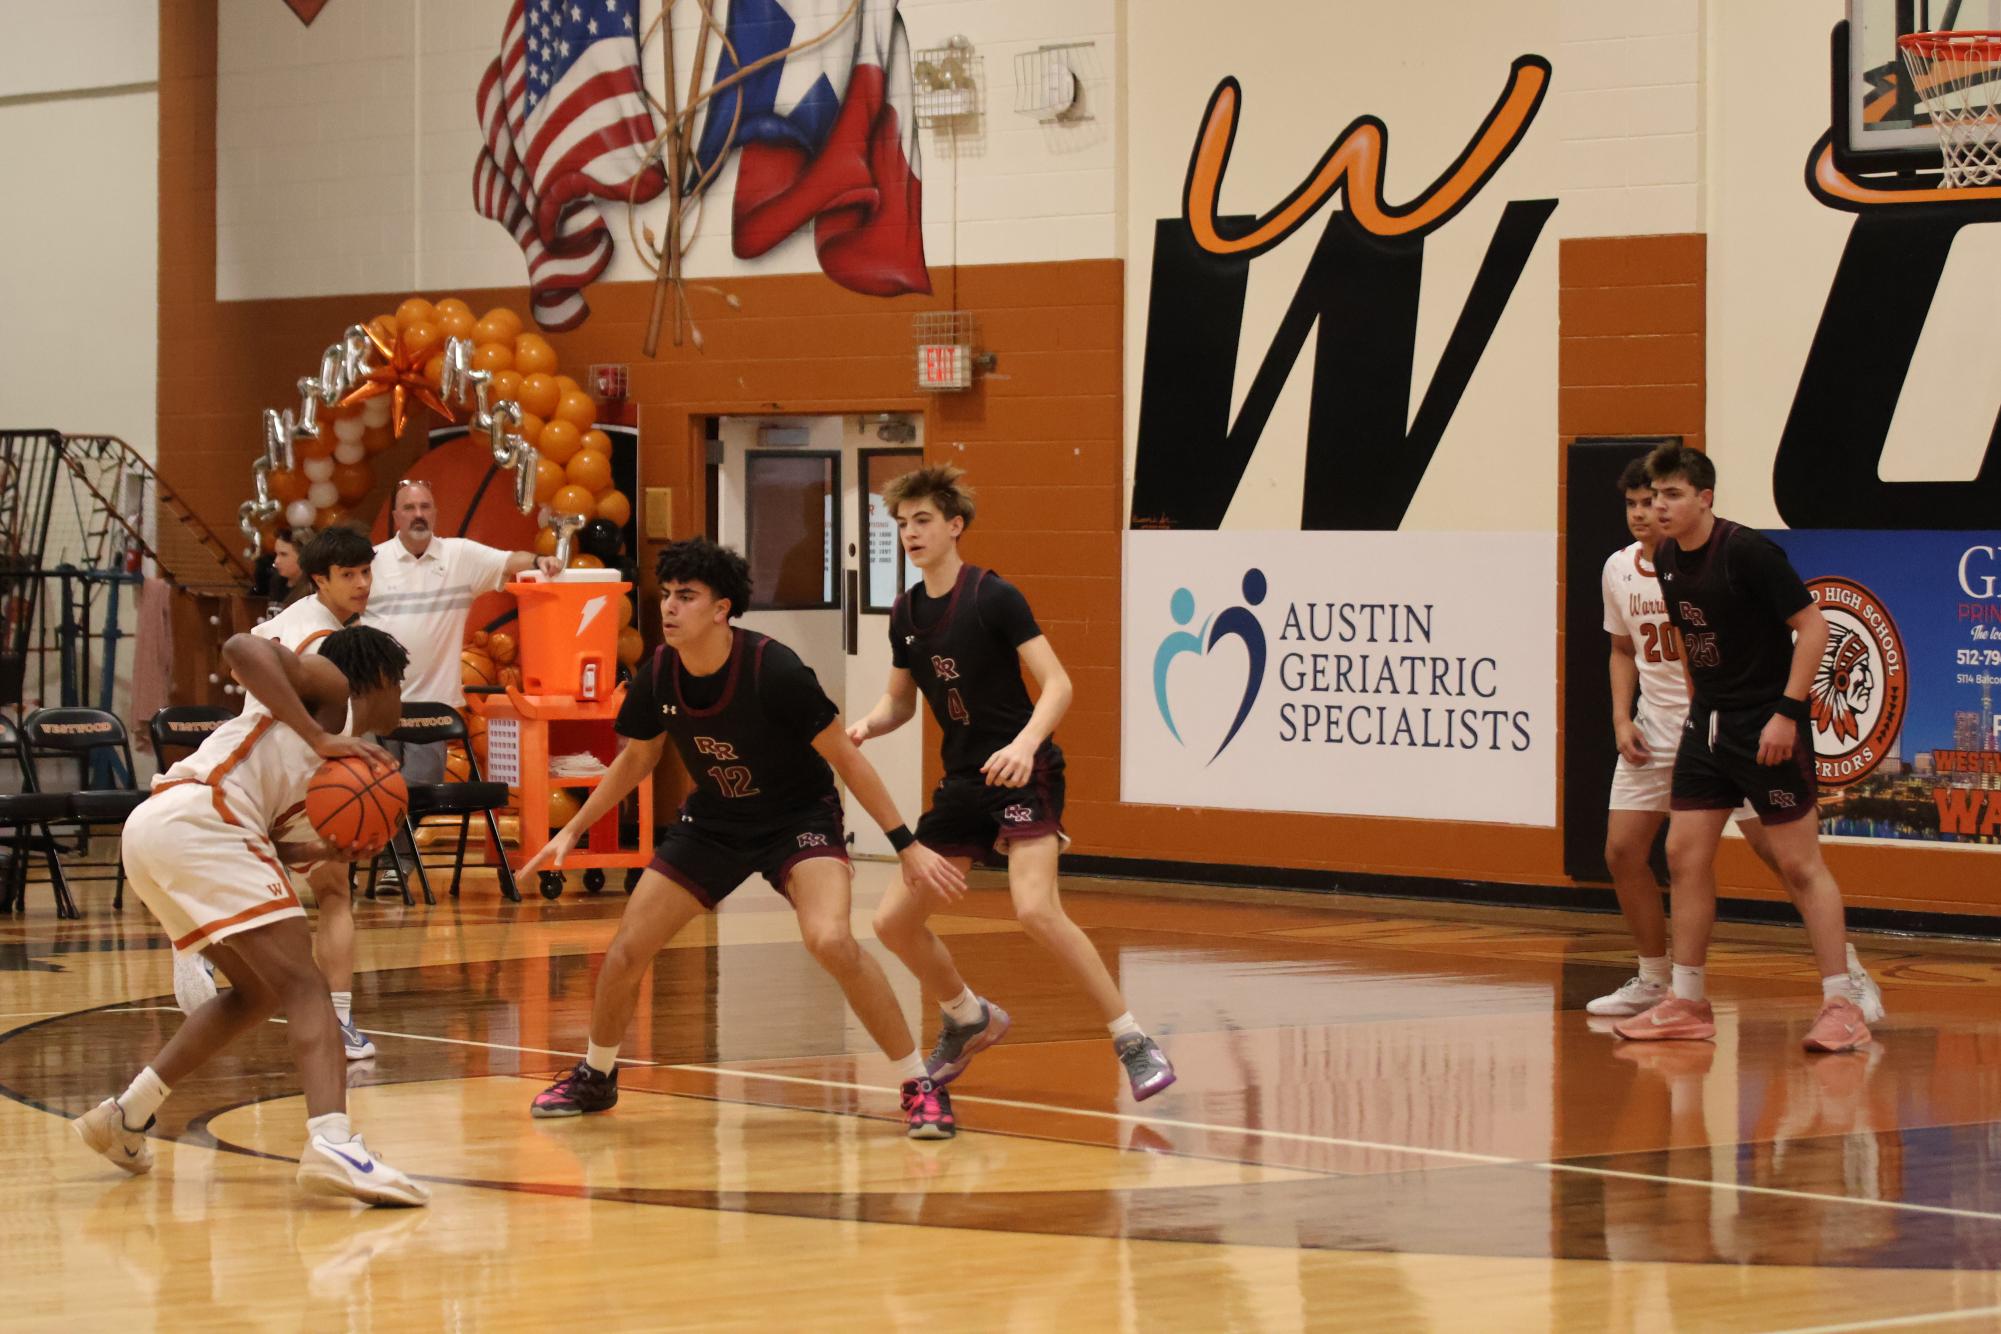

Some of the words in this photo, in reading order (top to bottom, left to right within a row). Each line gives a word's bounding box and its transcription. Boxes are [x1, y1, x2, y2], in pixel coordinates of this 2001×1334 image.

[927, 345, 955, 384] EXIT
[1958, 546, 2001, 599] G
[1279, 602, 1434, 644] AUSTIN
[1639, 621, 1680, 663] 20
[1824, 587, 1862, 610] HIGH
[1863, 604, 1900, 676] SCHOOL
[1279, 653, 1497, 698] GERIATRIC
[1956, 649, 2001, 666] 512-79
[1975, 674, 2001, 685] Balco
[948, 688, 970, 725] 4
[1279, 703, 1531, 752] SPECIALISTS
[694, 736, 739, 760] RR
[707, 766, 760, 798] 12
[266, 882, 283, 897] W
